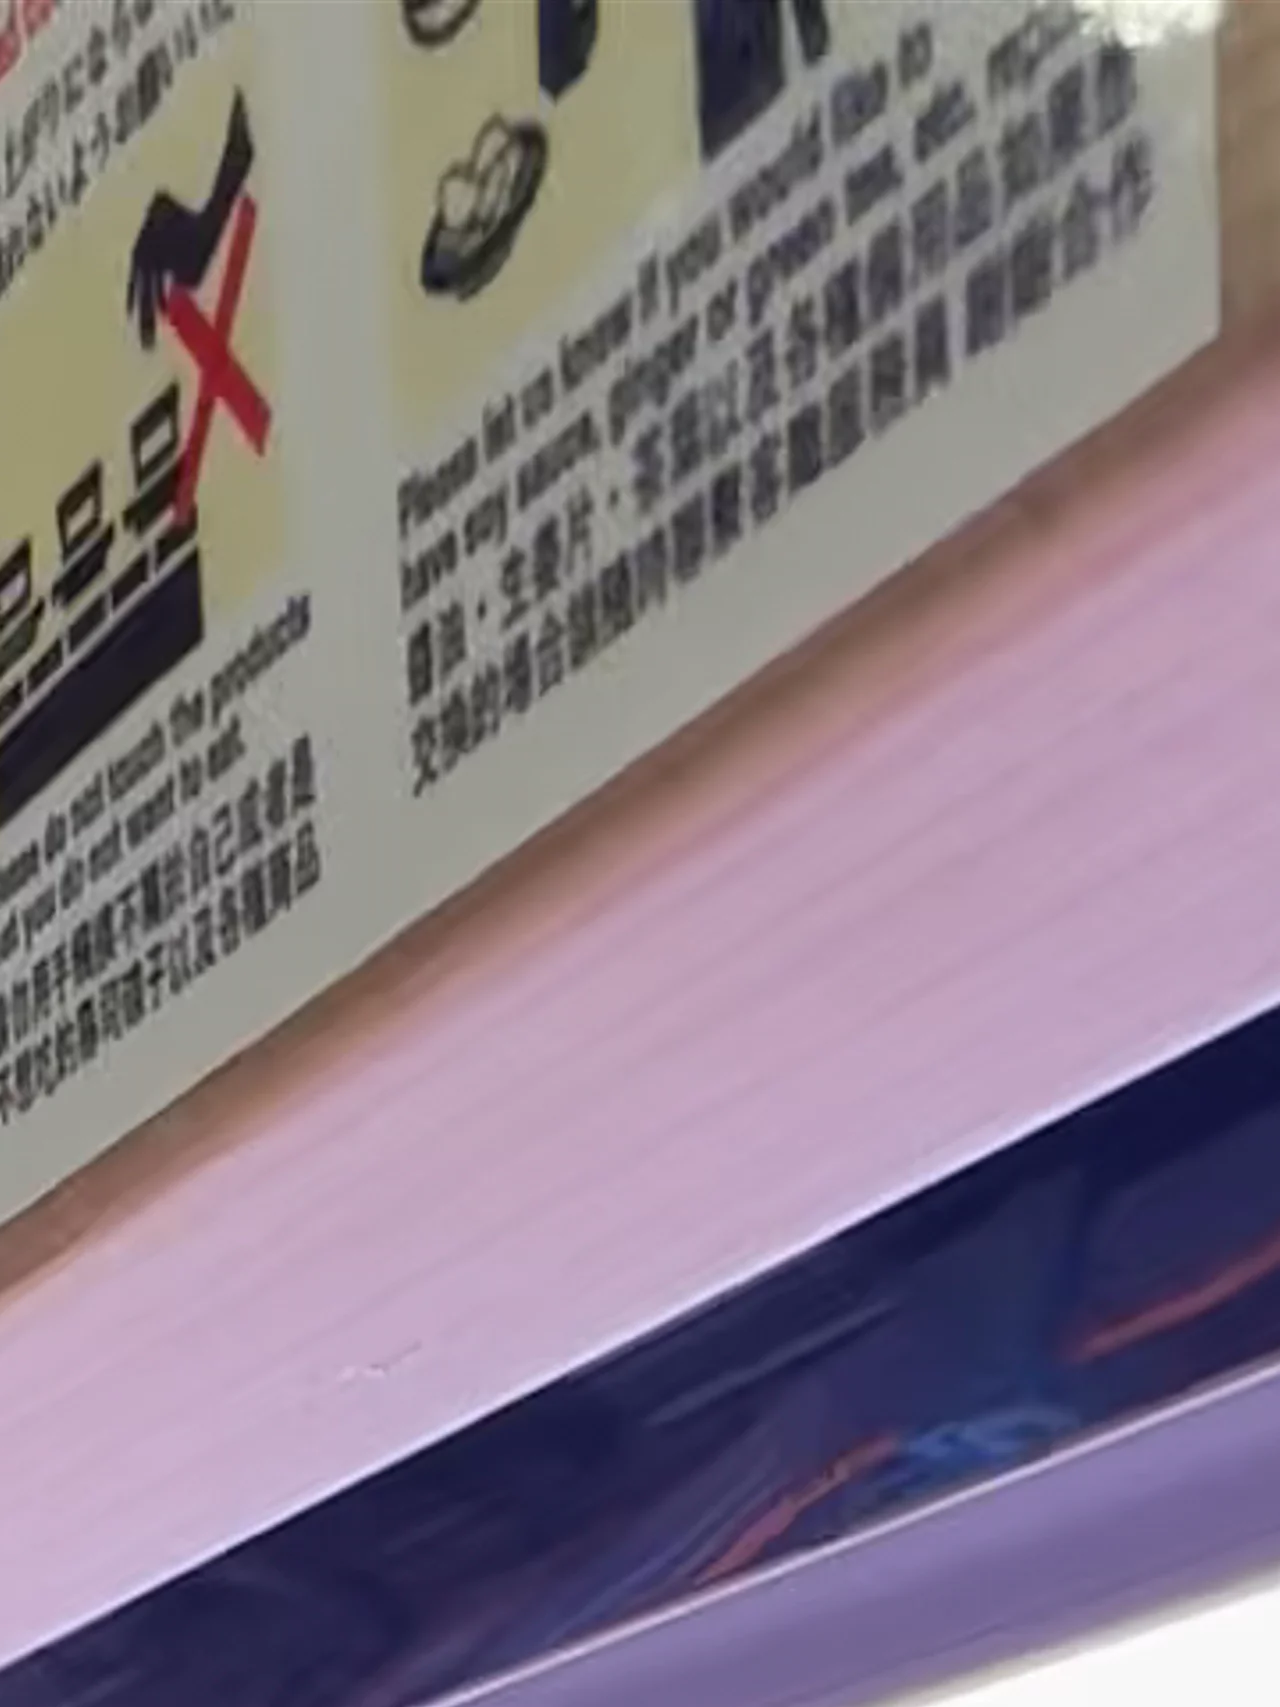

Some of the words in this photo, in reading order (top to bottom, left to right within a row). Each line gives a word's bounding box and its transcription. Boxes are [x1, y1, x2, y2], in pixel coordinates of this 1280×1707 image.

[108, 720, 166, 800] touch
[169, 687, 205, 748] the
[211, 594, 310, 727] products
